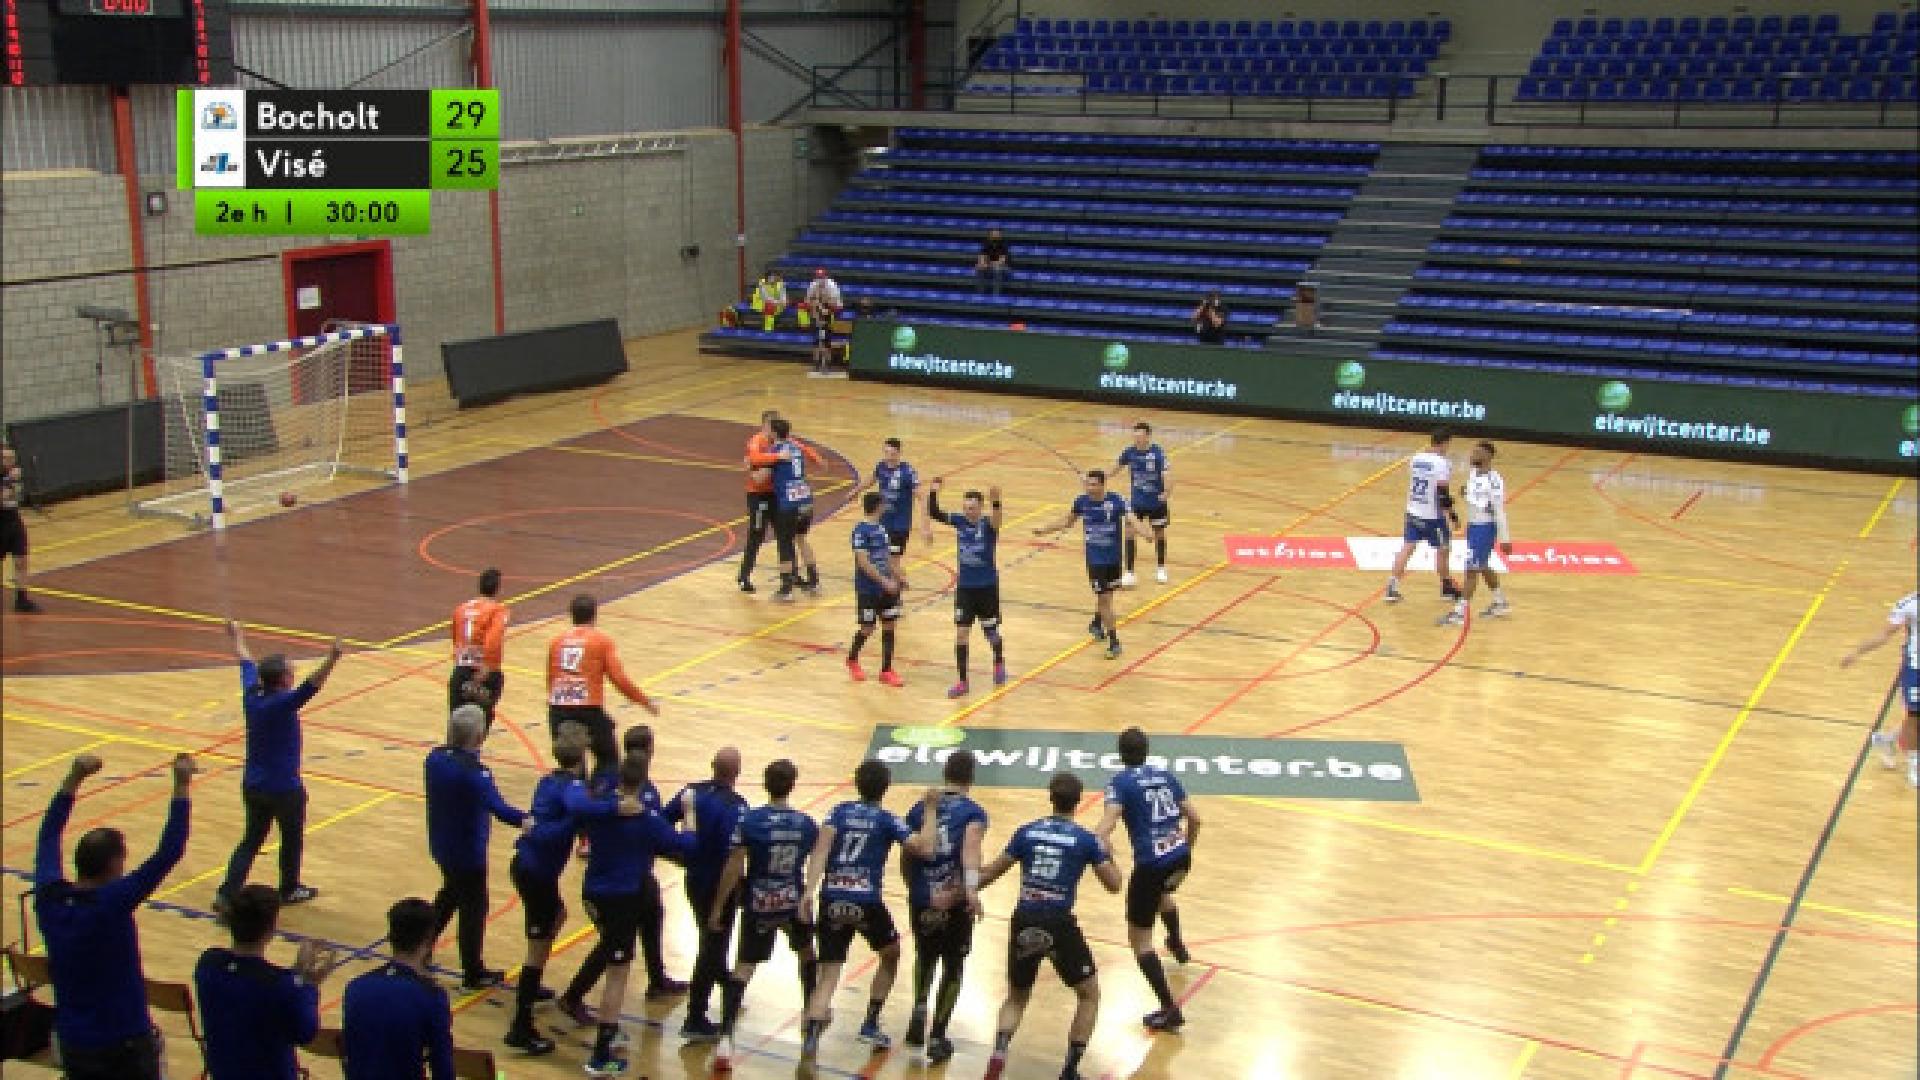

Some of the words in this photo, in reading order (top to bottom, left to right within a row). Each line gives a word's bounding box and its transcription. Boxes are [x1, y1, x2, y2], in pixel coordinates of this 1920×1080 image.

[889, 354, 1014, 379] elewijtcenter.be
[1100, 372, 1238, 399] elewijtcenter.be
[1333, 390, 1486, 421] elewijtcenter.be
[1595, 413, 1771, 445] elewijtcenter.be
